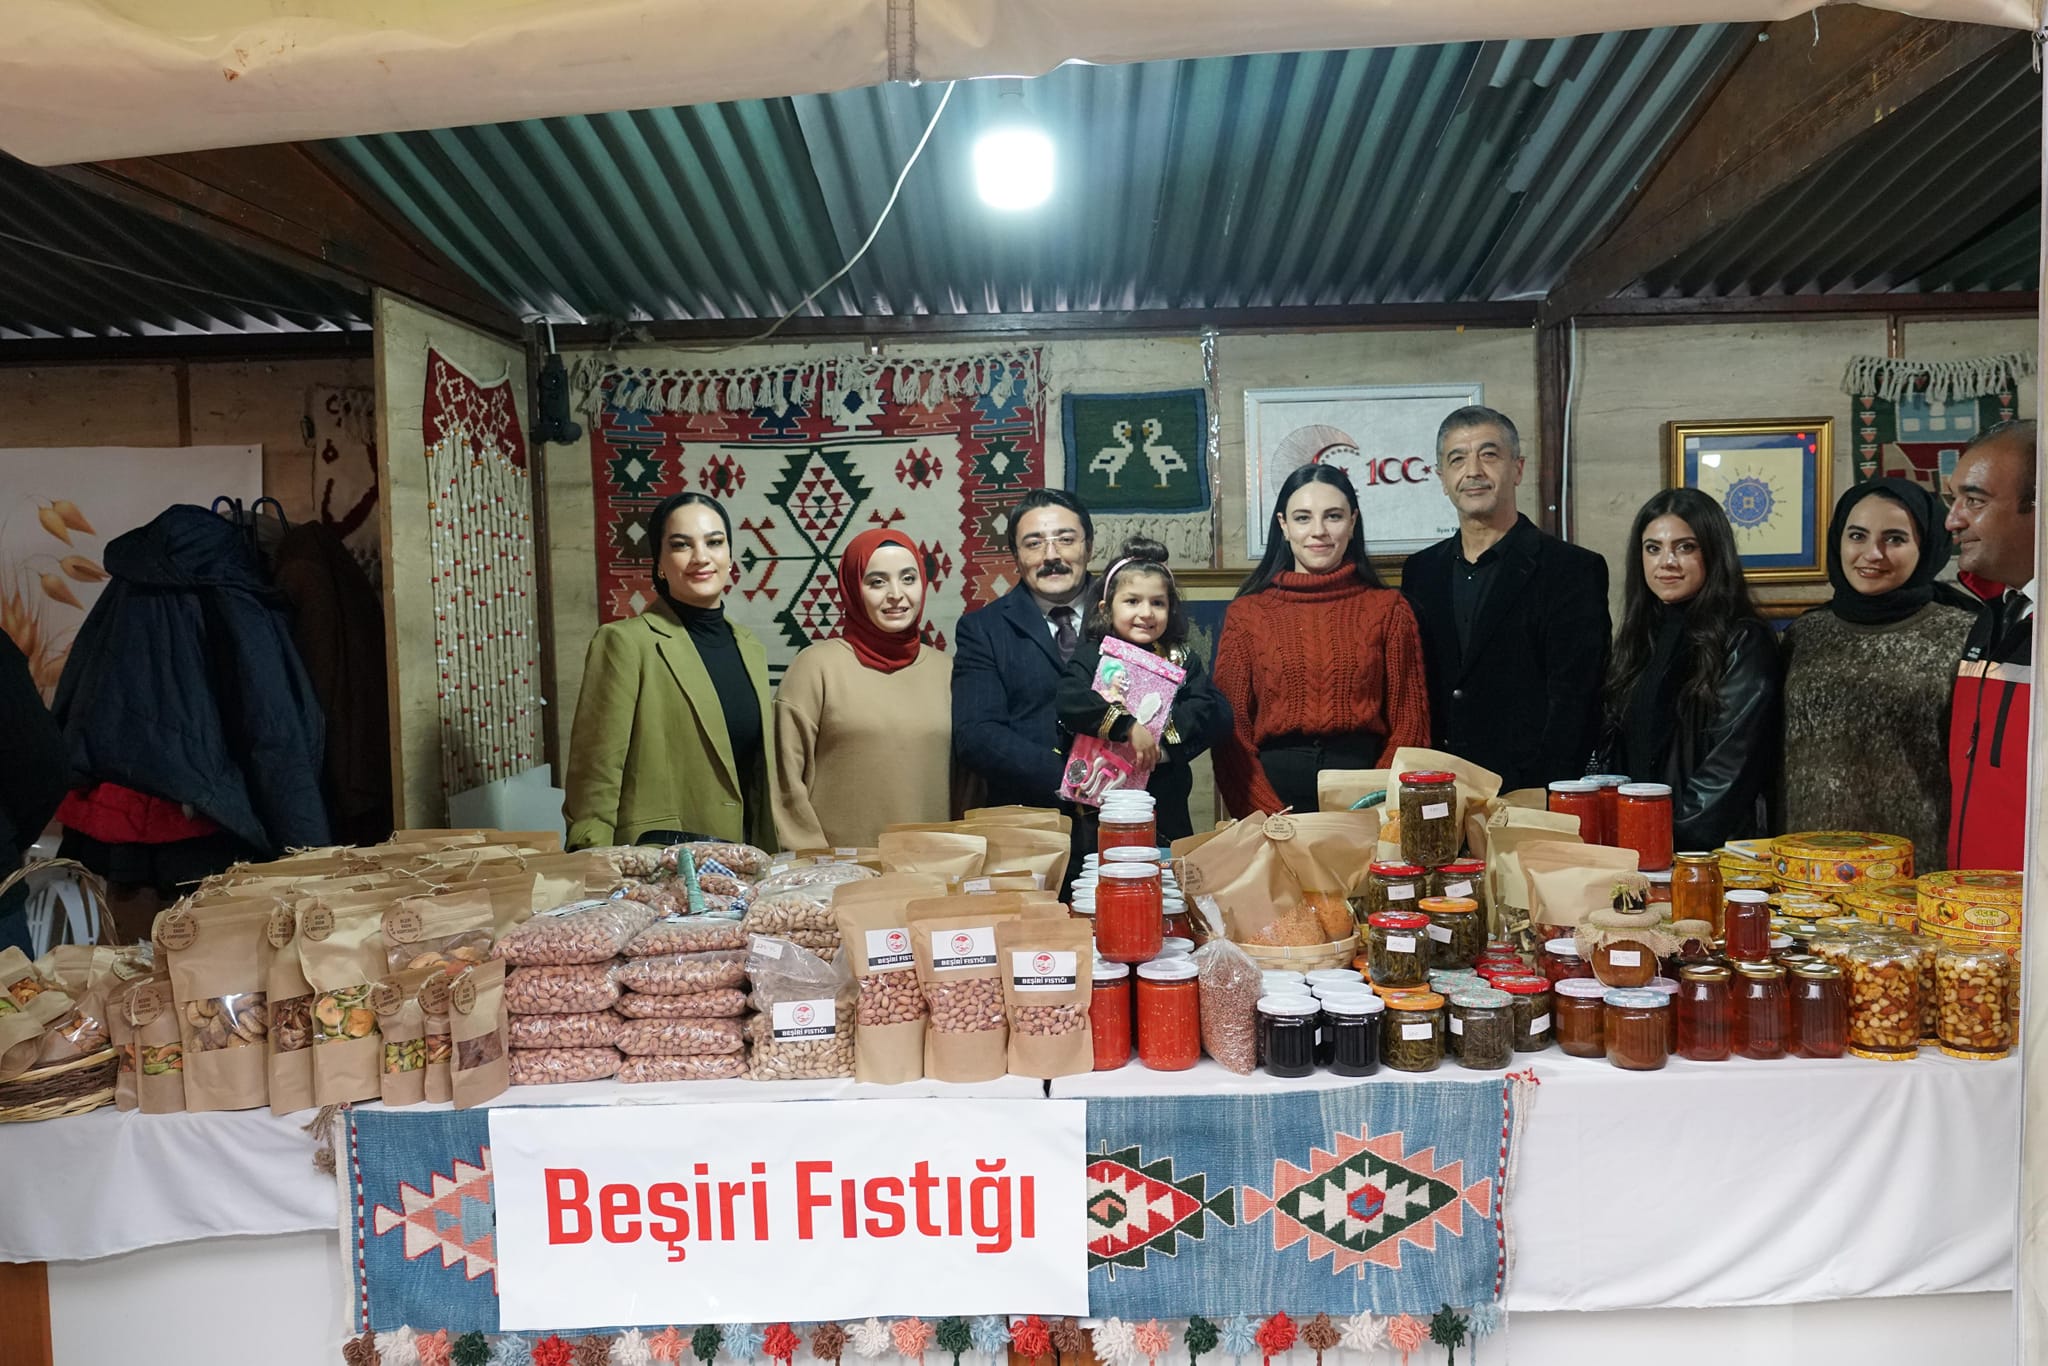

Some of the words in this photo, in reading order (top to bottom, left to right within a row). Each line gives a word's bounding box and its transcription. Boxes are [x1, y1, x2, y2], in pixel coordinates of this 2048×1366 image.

[941, 957, 963, 966] BEŞİRİ
[963, 956, 986, 964] FISTIĞI
[1022, 976, 1043, 985] BEŞİRİ
[1044, 976, 1067, 984] FISTIĞI
[781, 1028, 803, 1037] BEŞİRİ
[804, 1027, 827, 1036] FISTIĞI
[544, 1162, 769, 1262] Beşiri
[795, 1158, 1035, 1254] Fıstığı
